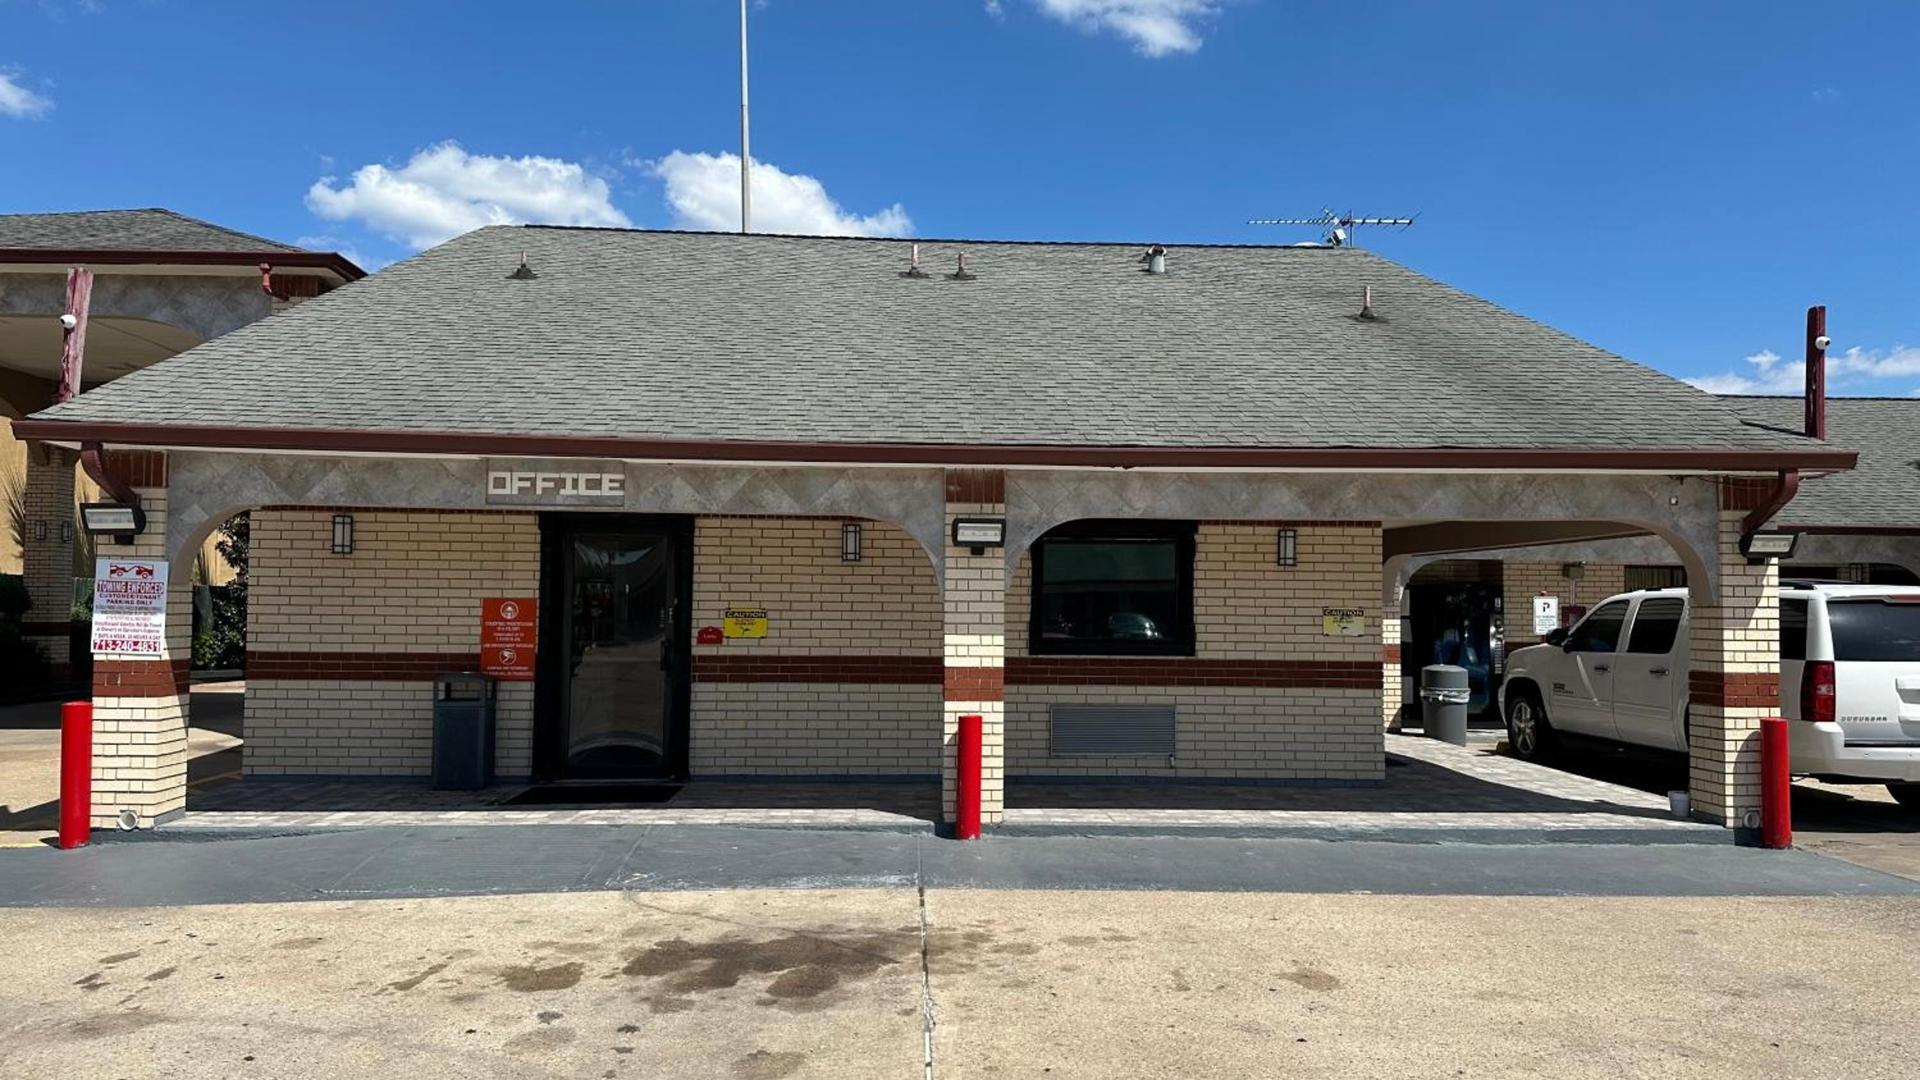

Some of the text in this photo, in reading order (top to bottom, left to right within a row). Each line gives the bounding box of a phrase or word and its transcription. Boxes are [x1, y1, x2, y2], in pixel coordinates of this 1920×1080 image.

[488, 472, 625, 495] OFFICE
[98, 581, 164, 594] TOWING ENFORCED
